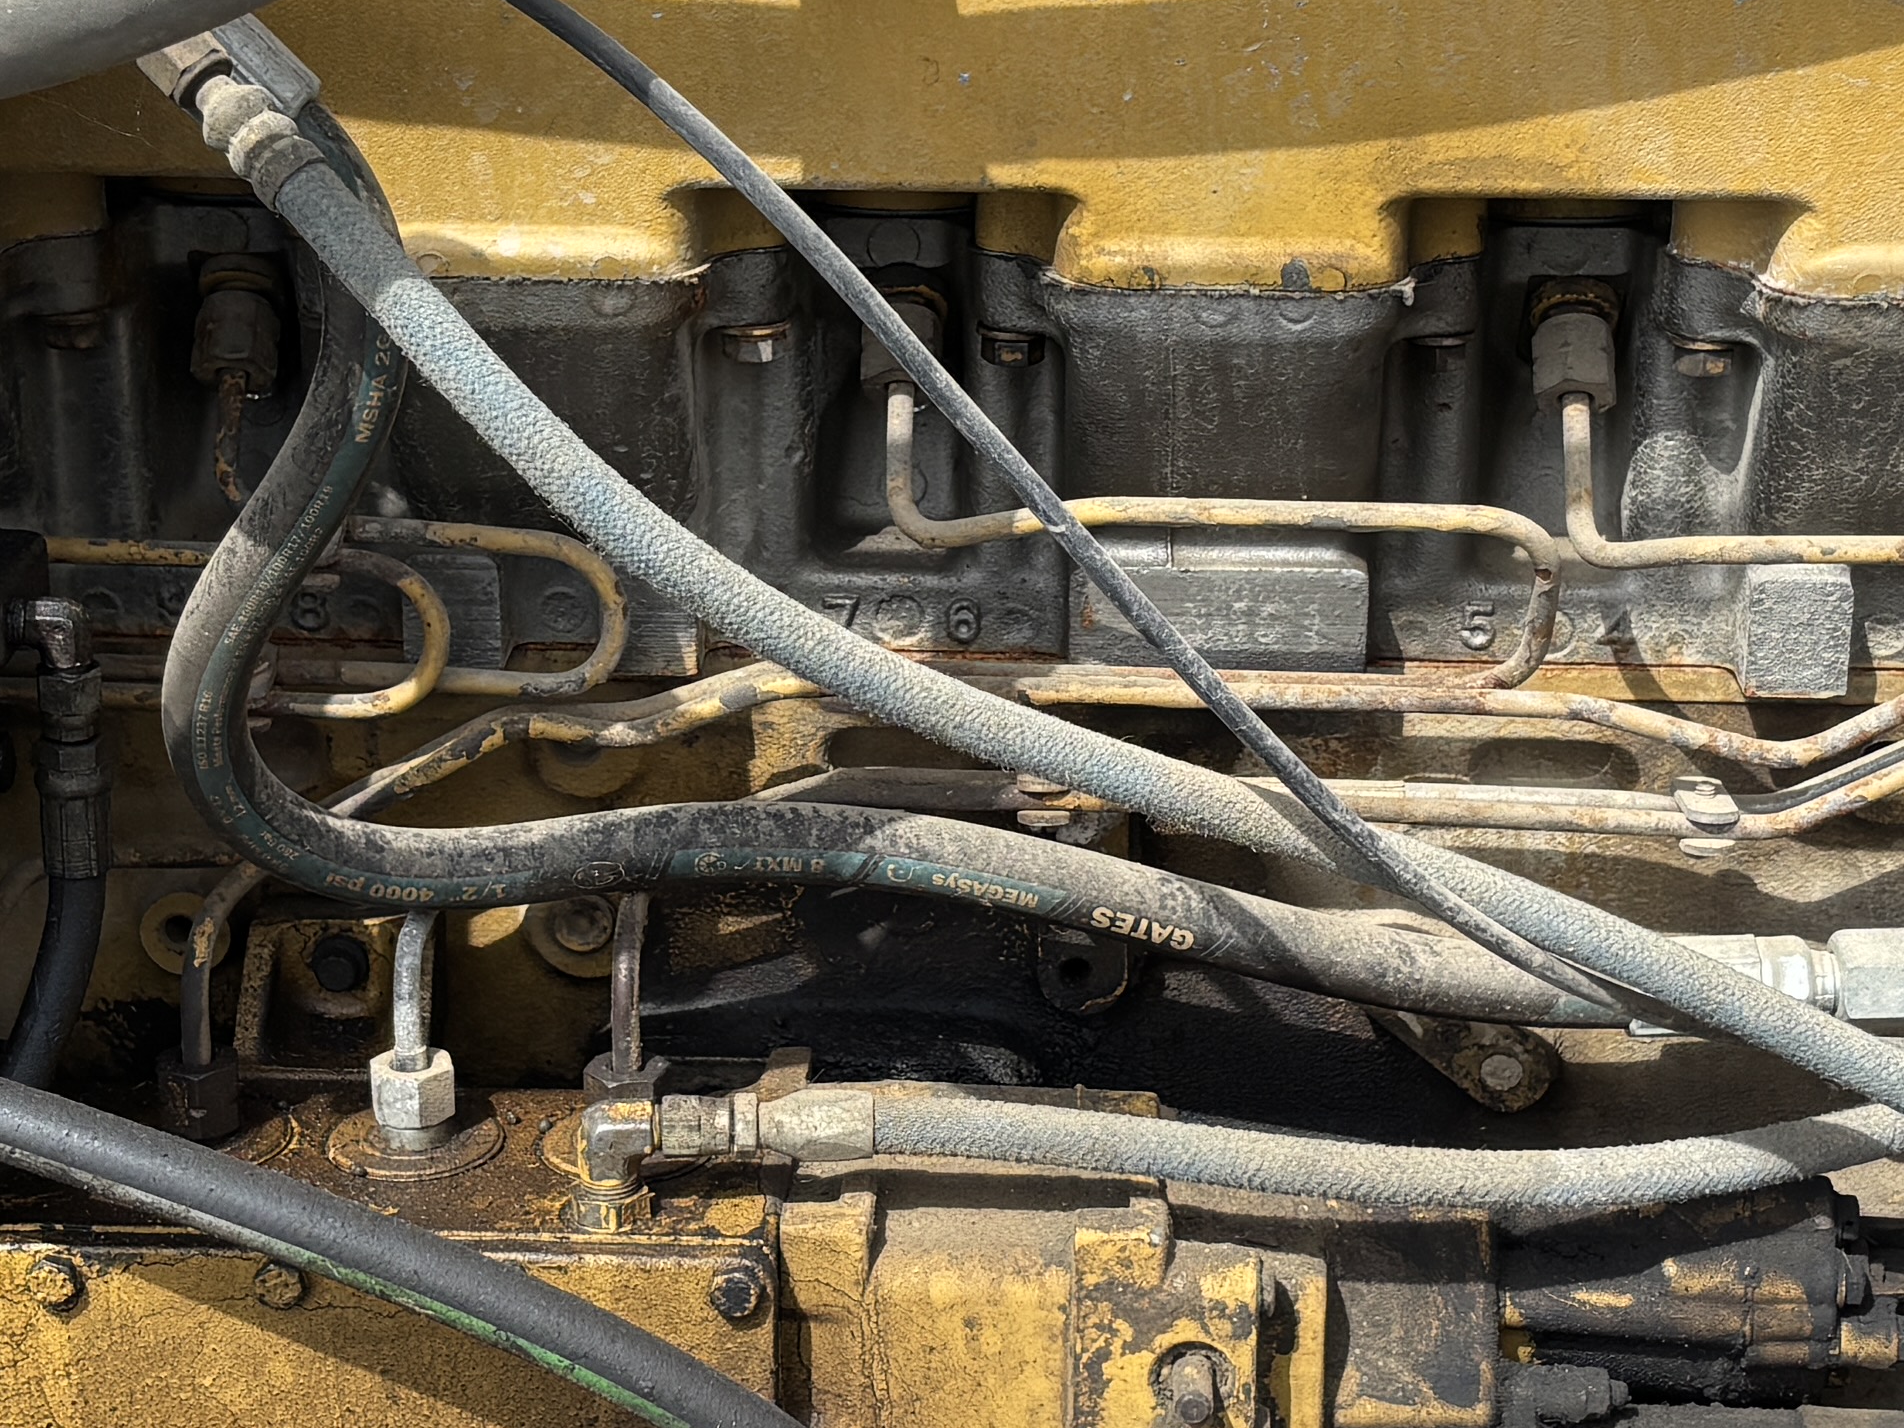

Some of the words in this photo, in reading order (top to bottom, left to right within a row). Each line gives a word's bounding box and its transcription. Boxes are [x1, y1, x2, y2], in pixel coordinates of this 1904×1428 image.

[353, 374, 388, 442] MSHA
[1460, 600, 1496, 650] 5
[323, 872, 365, 892] psi
[369, 883, 434, 902] 4000
[931, 871, 1038, 908] MEGASys
[1090, 906, 1195, 950] GATES
